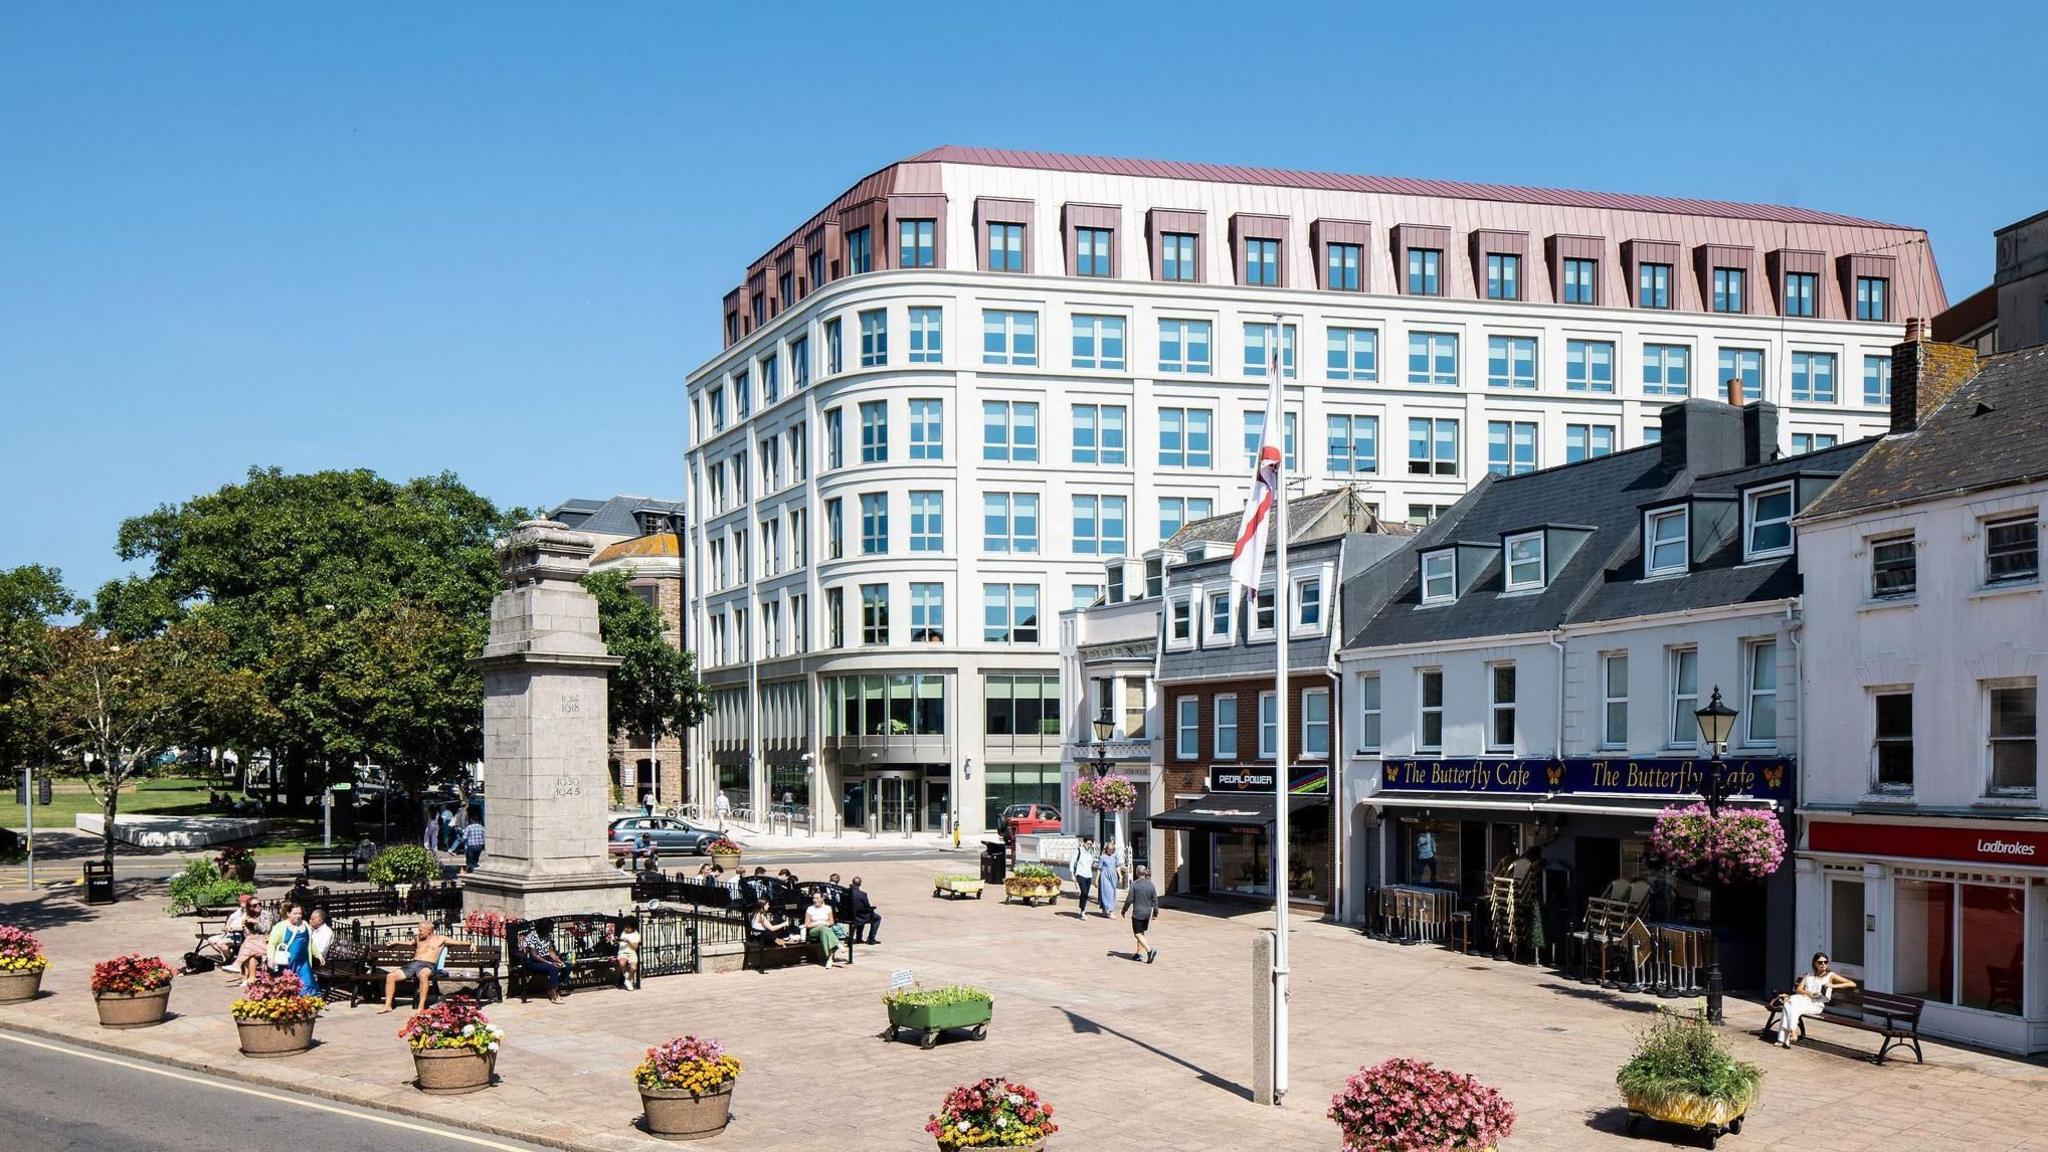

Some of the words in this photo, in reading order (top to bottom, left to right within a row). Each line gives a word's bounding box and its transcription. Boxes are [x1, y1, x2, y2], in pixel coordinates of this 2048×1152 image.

[1404, 762, 1426, 784] The
[1431, 761, 1491, 790] Butterfly
[1496, 762, 1530, 791] Cafe
[1592, 761, 1619, 787] The
[1627, 761, 1703, 795] Butterfly
[1977, 839, 2036, 856] Ladbrokes
